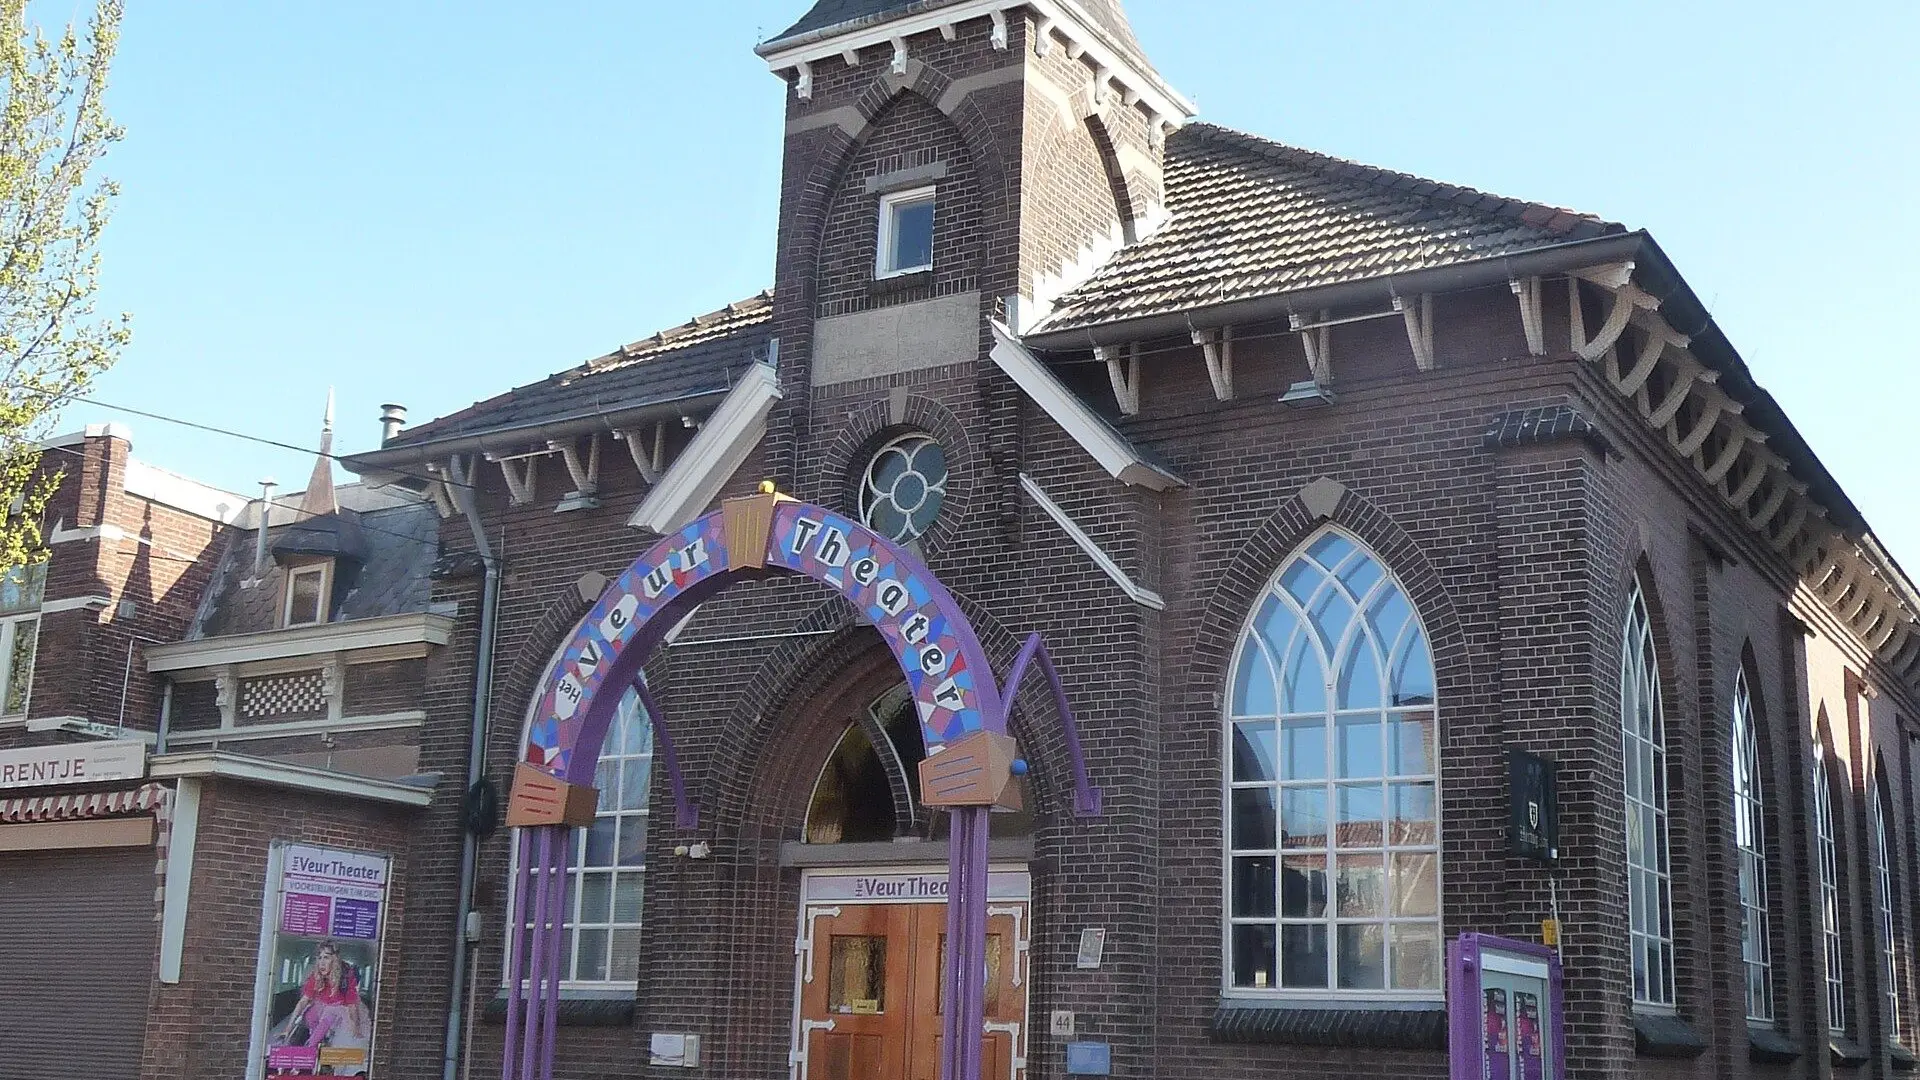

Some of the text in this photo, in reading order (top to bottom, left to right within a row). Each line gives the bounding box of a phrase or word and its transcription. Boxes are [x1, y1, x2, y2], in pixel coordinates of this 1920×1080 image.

[559, 519, 960, 703] Het Veur Theater
[0, 759, 86, 783] RENTJE
[299, 857, 330, 874] Veur
[331, 861, 380, 880] Theater
[864, 878, 905, 896] Veur
[907, 877, 950, 896] Thea
[1056, 1015, 1070, 1031] 44
